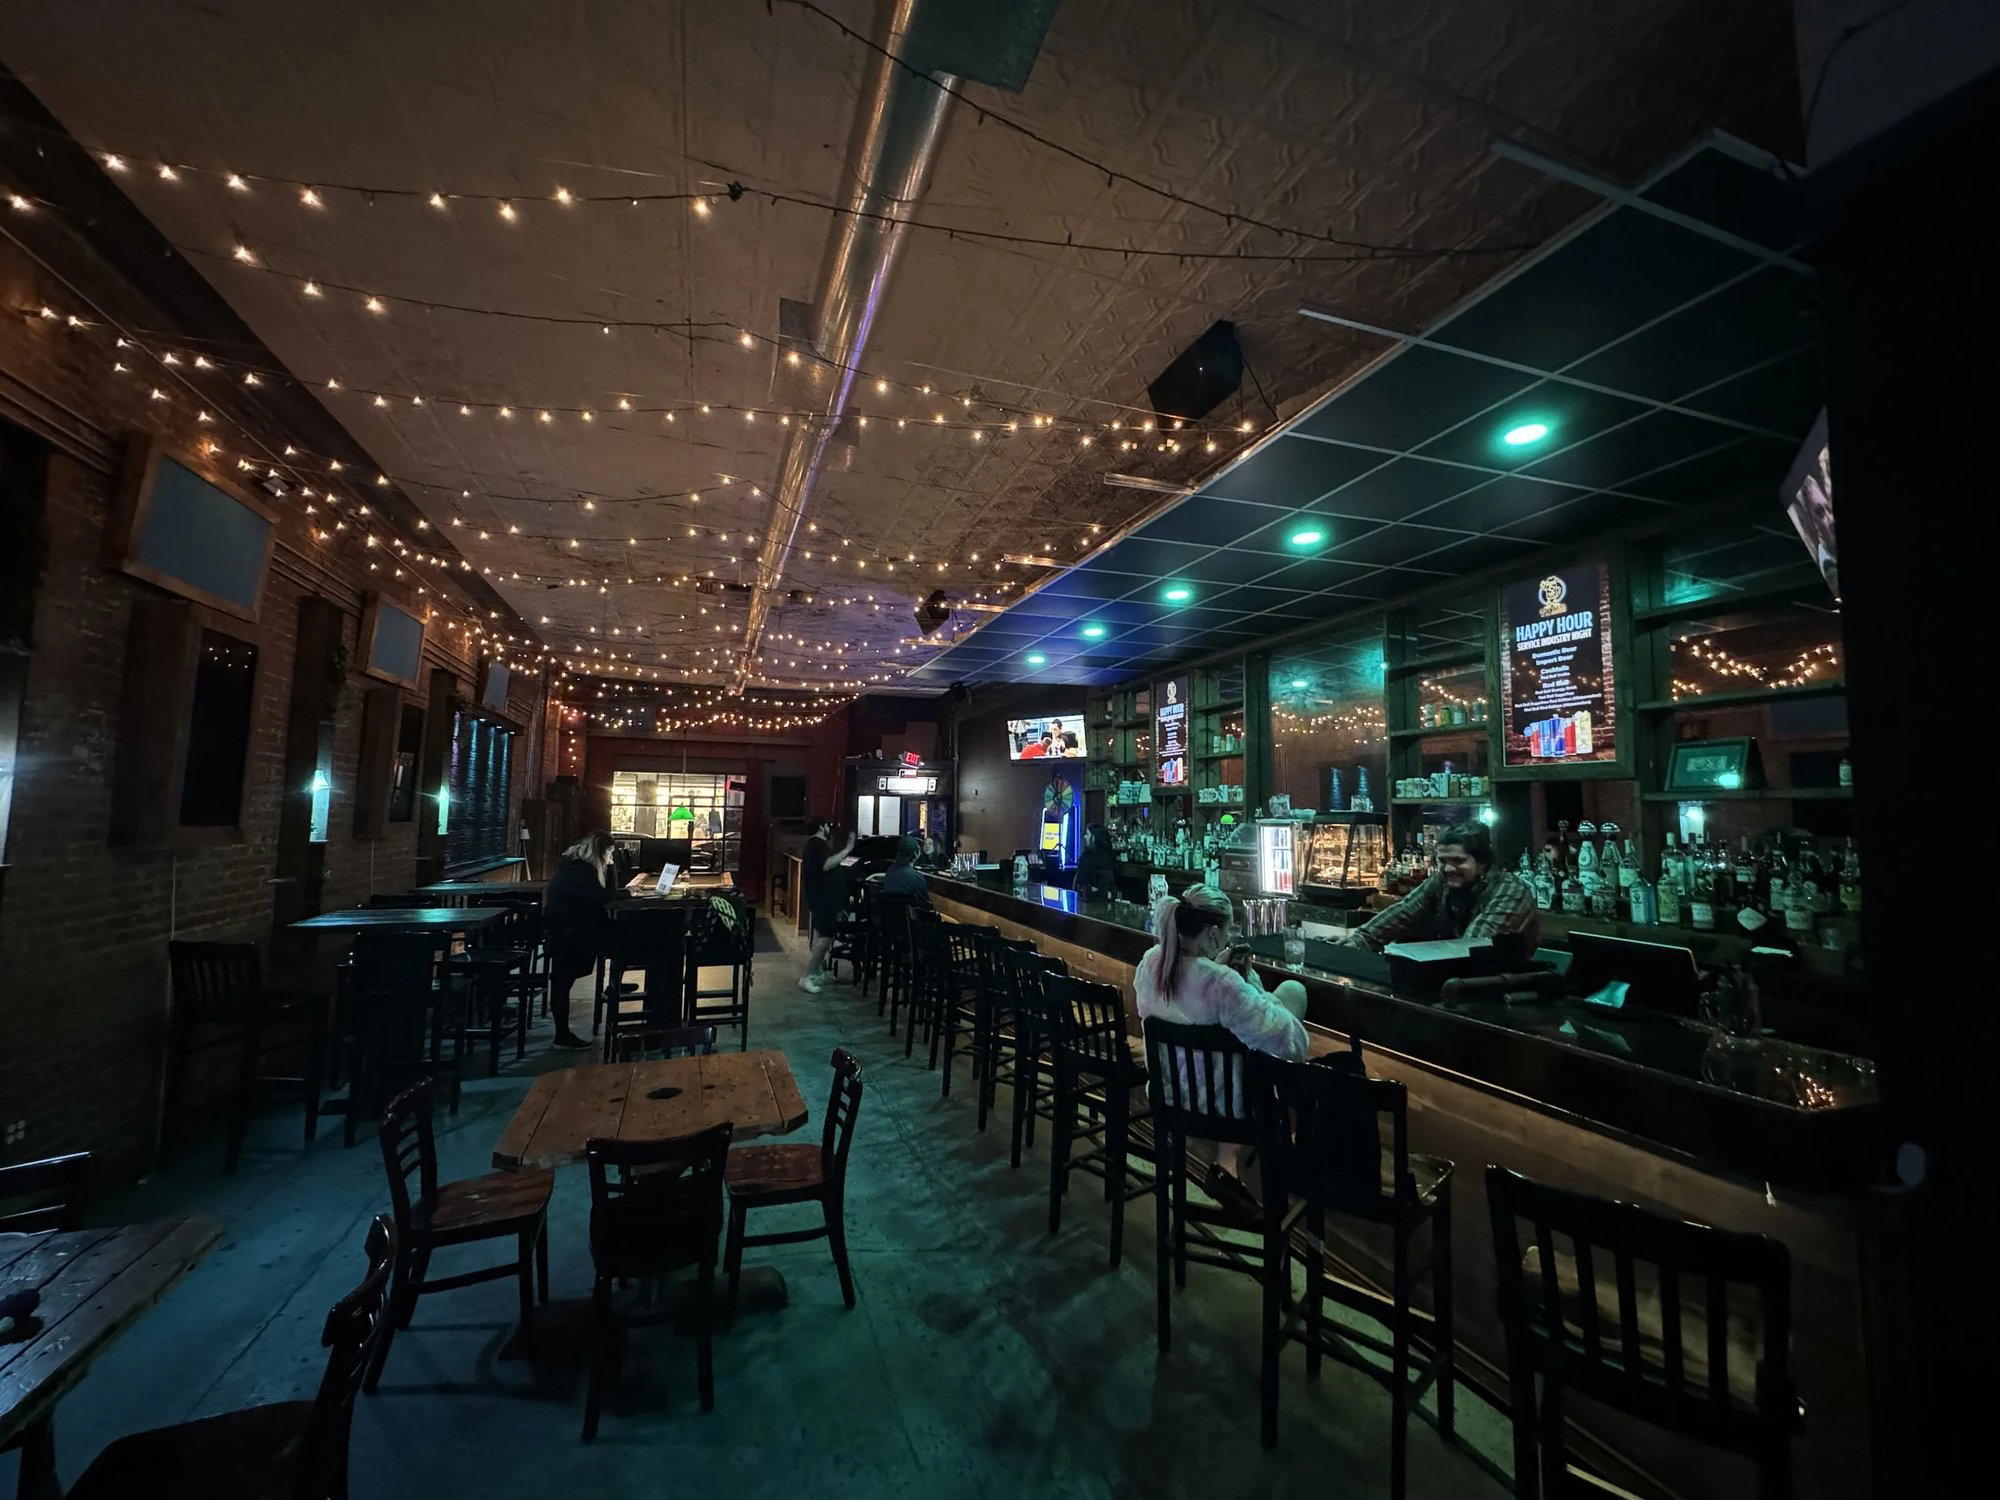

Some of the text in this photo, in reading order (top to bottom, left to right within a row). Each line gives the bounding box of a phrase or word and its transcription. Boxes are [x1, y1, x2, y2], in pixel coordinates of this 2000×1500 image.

[1516, 619, 1554, 642] HAPPY
[1556, 611, 1593, 633] HOUR
[1517, 628, 1592, 651] SERVICE INDUSTRY NIGHT
[905, 752, 919, 764] EXIT
